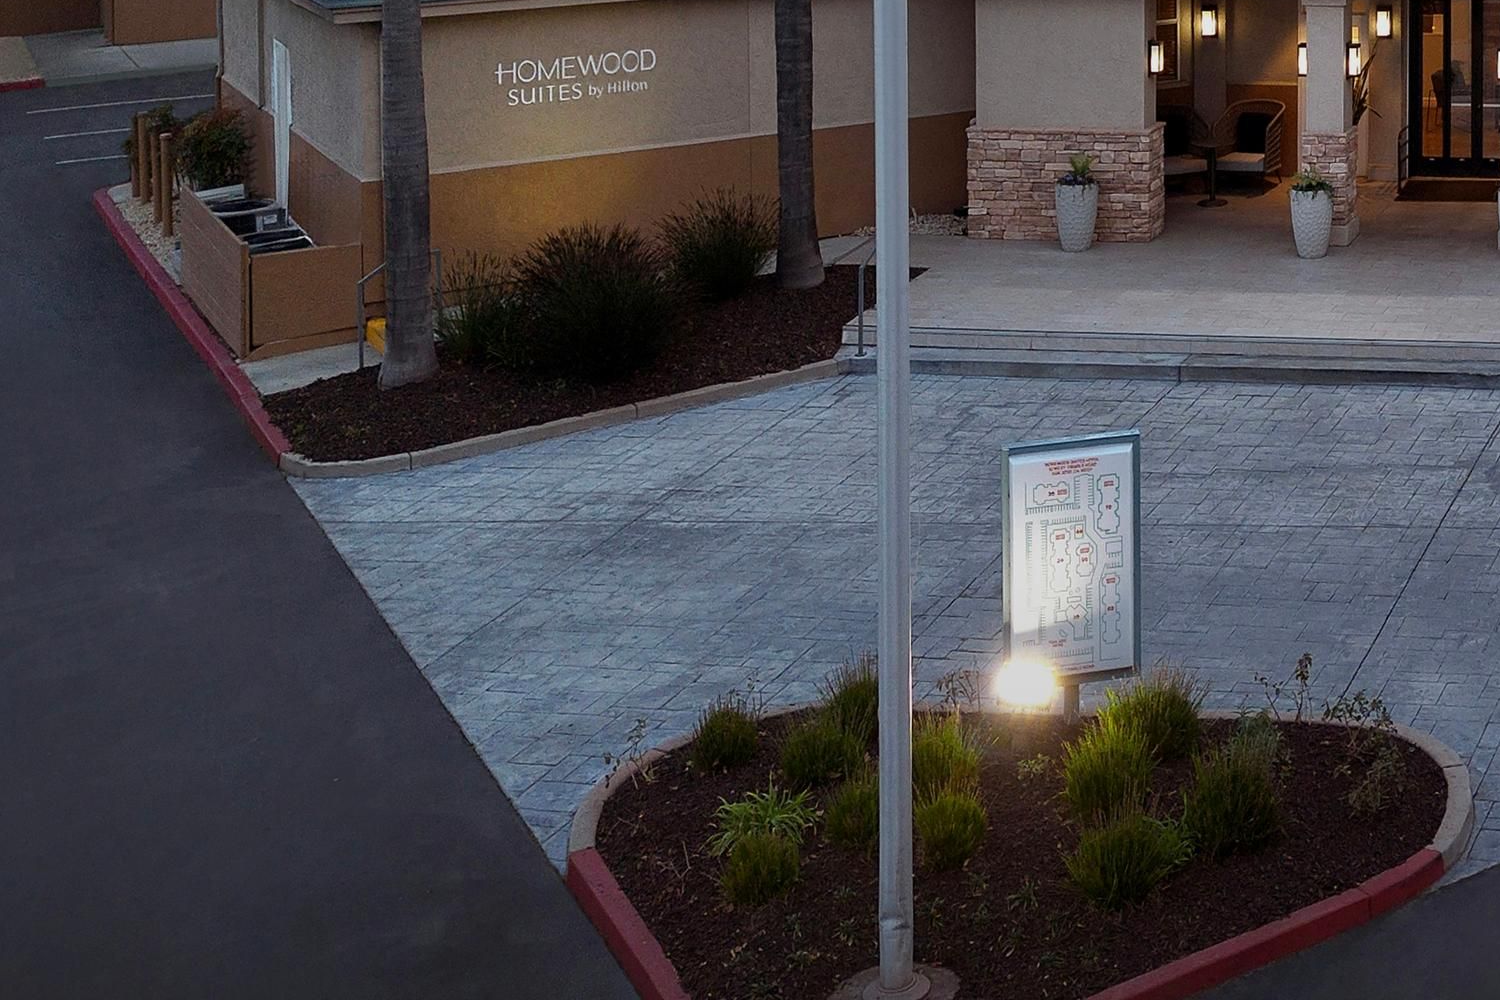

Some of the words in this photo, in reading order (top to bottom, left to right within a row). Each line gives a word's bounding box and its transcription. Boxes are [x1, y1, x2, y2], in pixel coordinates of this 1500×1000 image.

[494, 49, 657, 85] HOMEWOOD
[508, 83, 583, 106] SUITES
[588, 84, 603, 99] by
[607, 80, 648, 94] Hilton
